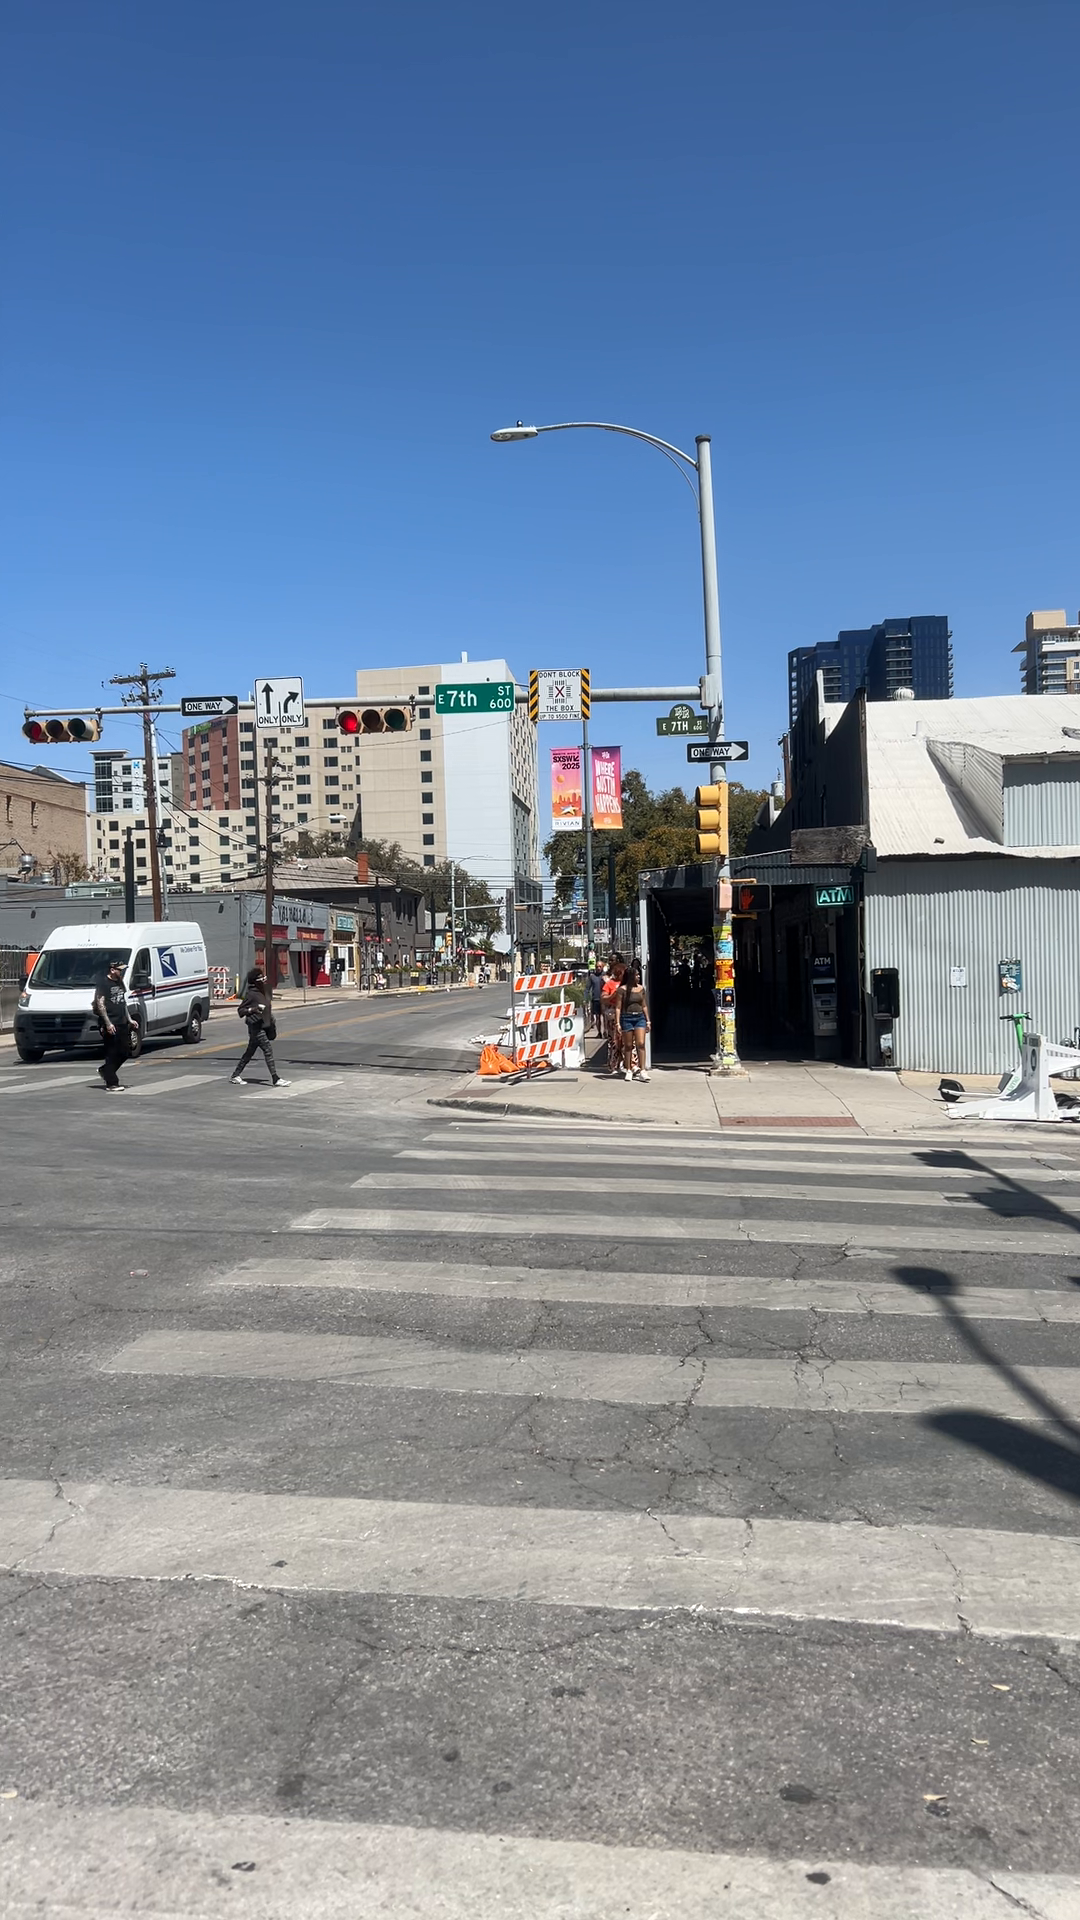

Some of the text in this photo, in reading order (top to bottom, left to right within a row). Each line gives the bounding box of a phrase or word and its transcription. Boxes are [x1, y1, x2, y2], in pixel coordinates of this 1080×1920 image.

[497, 686, 512, 696] ST
[438, 690, 478, 708] E 7th
[489, 698, 512, 710] 600
[186, 701, 221, 711] ONE WAY
[258, 716, 278, 724] ONLY
[281, 714, 302, 723] ONLY
[671, 721, 688, 732] 7TH
[693, 748, 730, 757] ONE WAY
[595, 759, 615, 777] WHERE
[595, 794, 621, 814] HAPPENS
[820, 888, 852, 902] ATM
[814, 957, 831, 966] ATM
